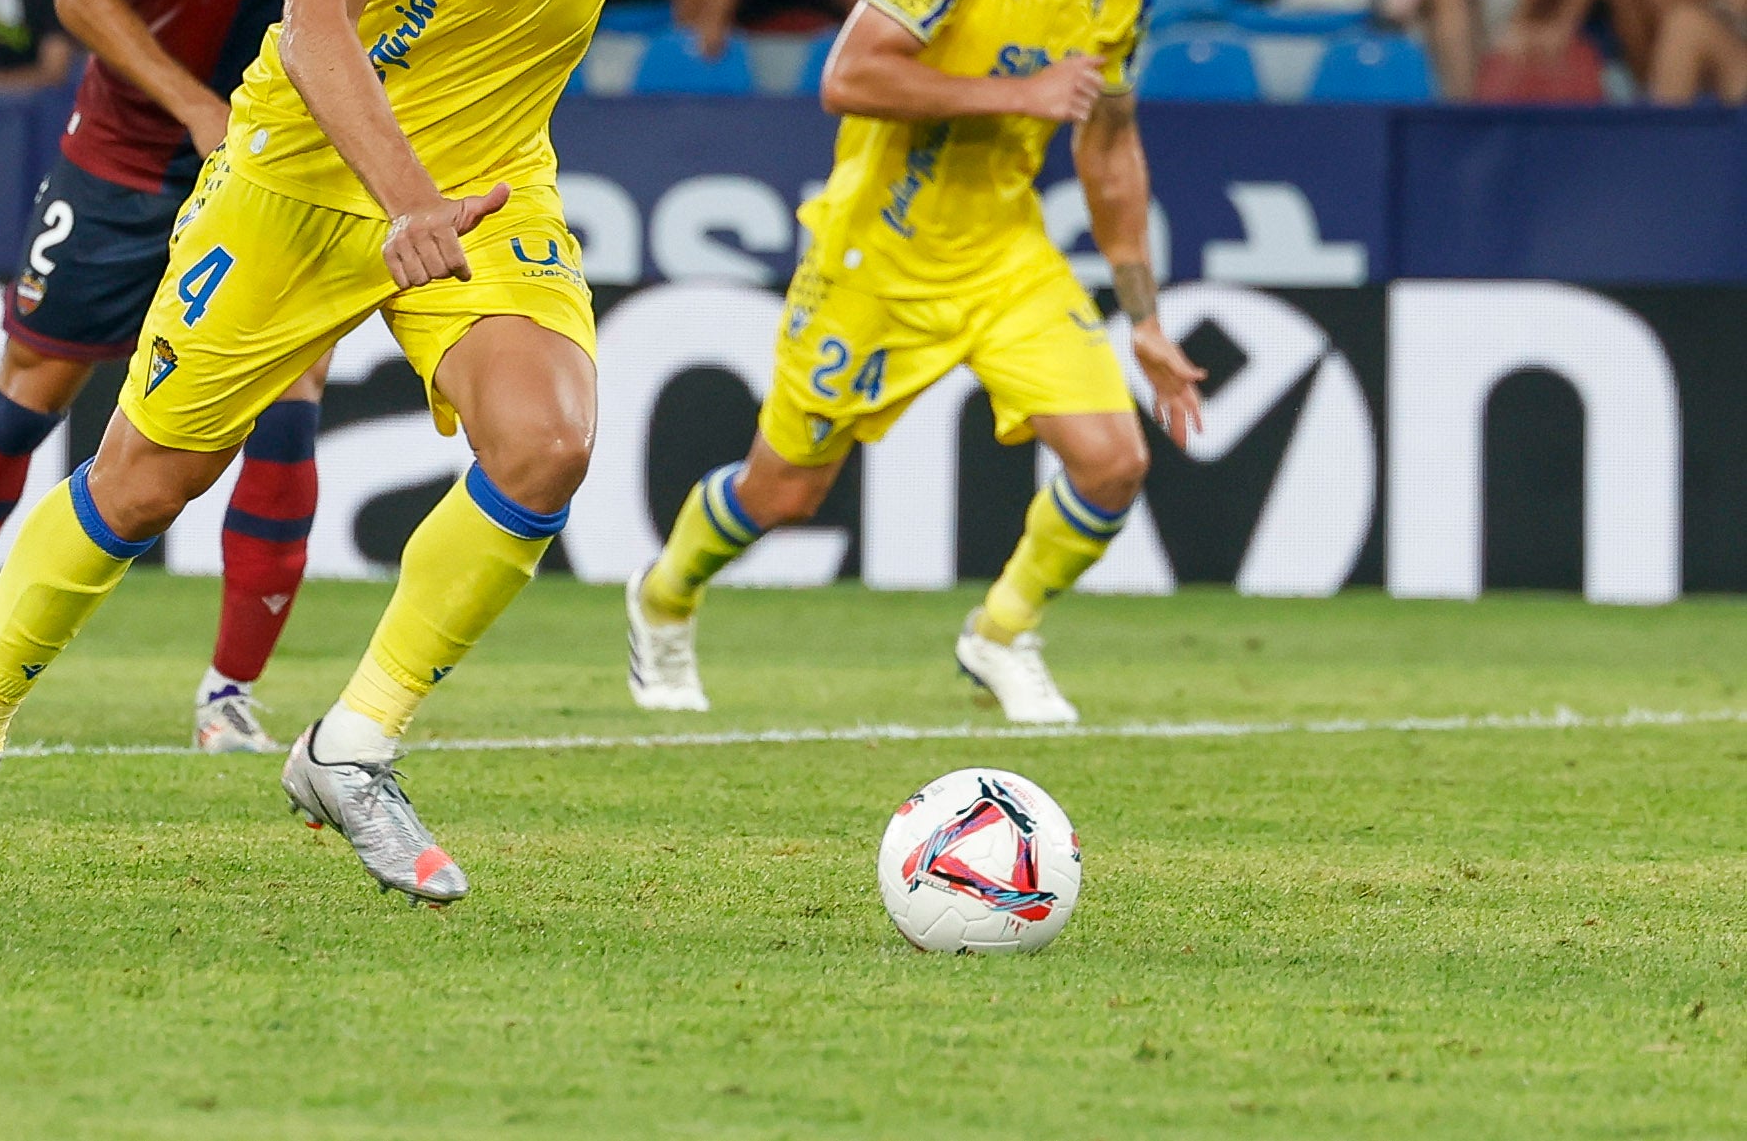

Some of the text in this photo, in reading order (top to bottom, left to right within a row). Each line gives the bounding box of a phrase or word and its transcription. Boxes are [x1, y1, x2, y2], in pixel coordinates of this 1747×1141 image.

[29, 199, 74, 276] 2
[178, 246, 235, 328] 4
[811, 339, 889, 401] 24
